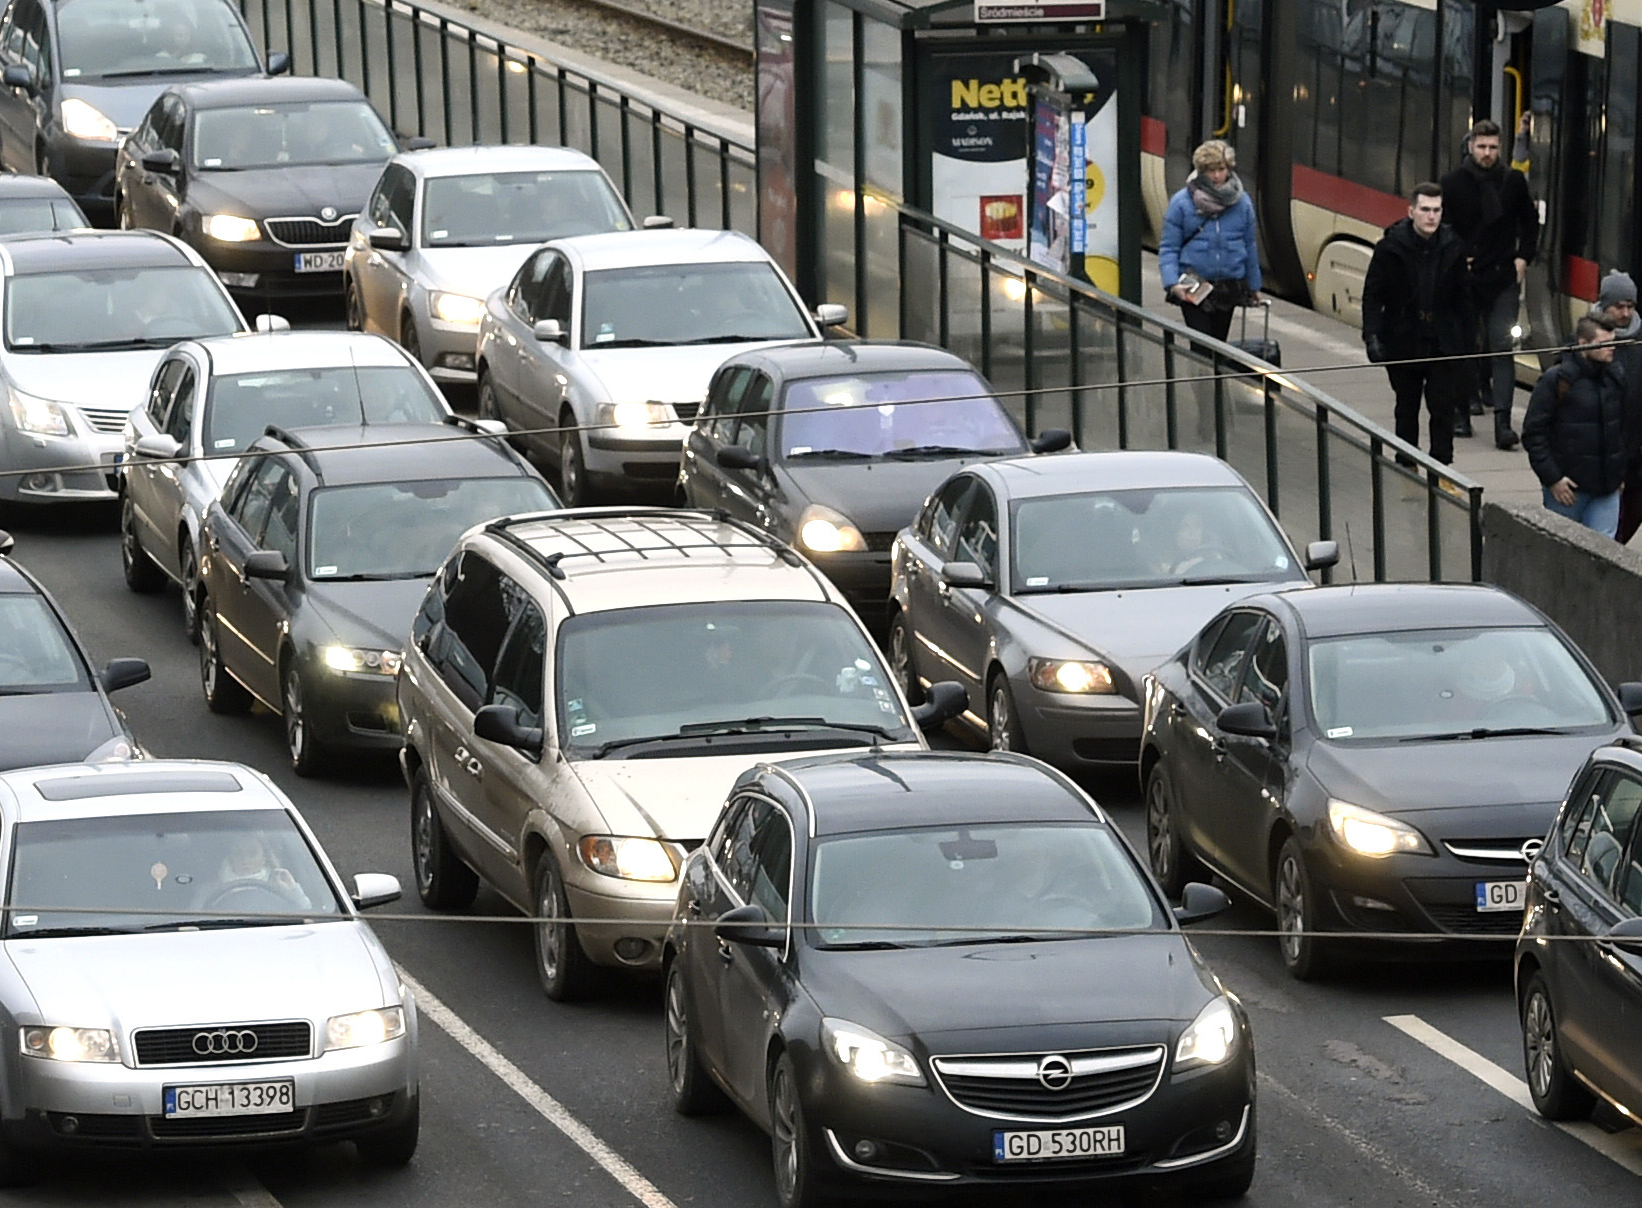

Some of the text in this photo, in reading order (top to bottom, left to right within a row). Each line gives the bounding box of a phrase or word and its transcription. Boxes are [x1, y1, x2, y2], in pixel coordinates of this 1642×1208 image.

[303, 255, 323, 269] WD
[1490, 884, 1517, 904] GD
[178, 1085, 290, 1110] GCH 13398
[1009, 1129, 1121, 1156] GD 530RH
